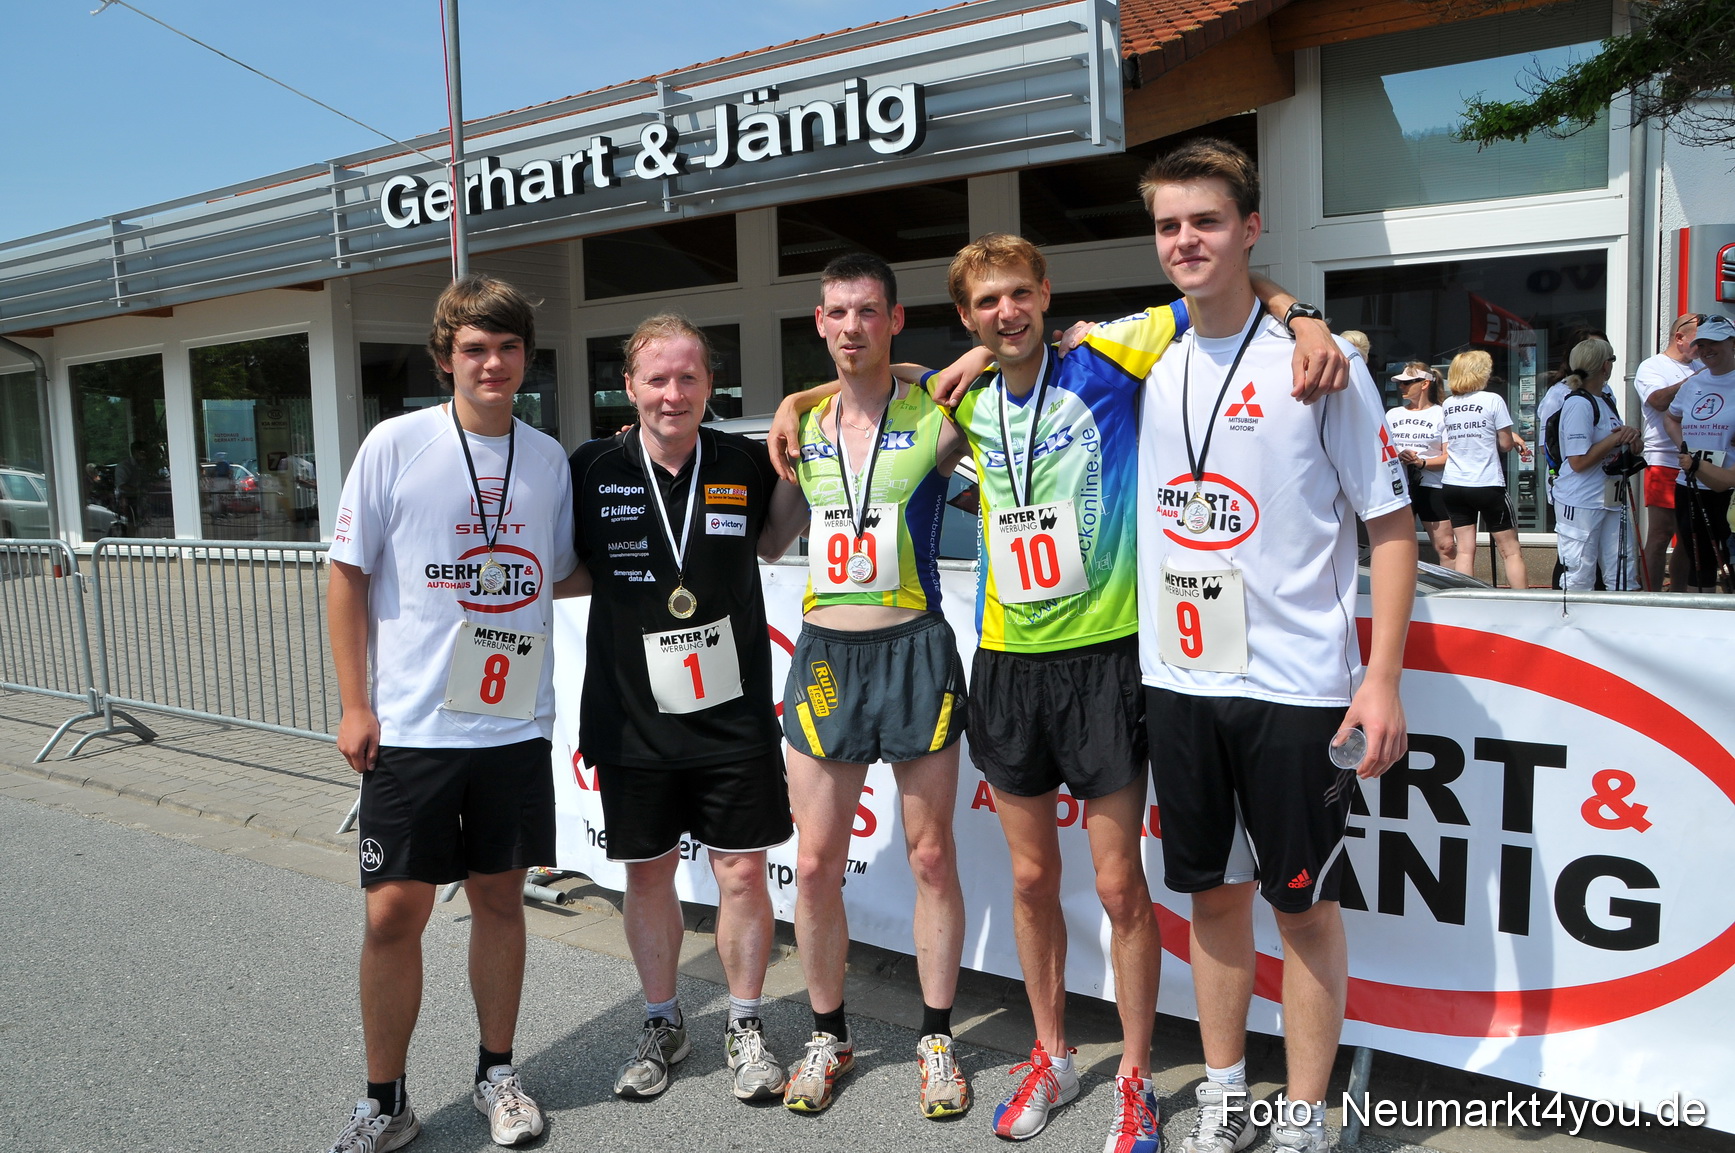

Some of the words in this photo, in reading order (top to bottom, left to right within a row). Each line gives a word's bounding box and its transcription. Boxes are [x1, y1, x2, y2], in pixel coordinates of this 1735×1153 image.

[380, 136, 616, 229] Gerhart
[634, 122, 685, 181] &
[705, 77, 922, 169] Jänig
[1444, 404, 1483, 417] BERGER
[1393, 418, 1433, 429] BERGER
[1464, 420, 1487, 430] GIRLS
[1412, 432, 1435, 440] GIRLS
[598, 484, 645, 496] Cellagon
[611, 504, 645, 516] killtec
[1230, 499, 1240, 511] &
[999, 510, 1035, 525] MEYER
[455, 524, 526, 535] SEAT
[720, 520, 744, 530] victory
[1000, 522, 1038, 533] WERBUNG
[608, 540, 648, 550] AMADEUS
[827, 532, 878, 584] 90
[1010, 533, 1061, 591] 10
[524, 565, 534, 575] &
[427, 581, 471, 589] AUTOHAUS
[1164, 571, 1198, 588] MEYER
[1165, 585, 1200, 598] WERBUNG
[474, 627, 517, 645] MEYER
[1176, 601, 1203, 659] 9
[473, 638, 515, 652] WERBUNG
[660, 631, 702, 646] MEYER
[660, 641, 704, 653] WERBUNG
[480, 653, 510, 705] 8
[683, 653, 705, 700] 1
[815, 666, 838, 703] Run!
[812, 686, 827, 714] Team
[1580, 768, 1653, 834] &
[362, 852, 380, 865] FCN
